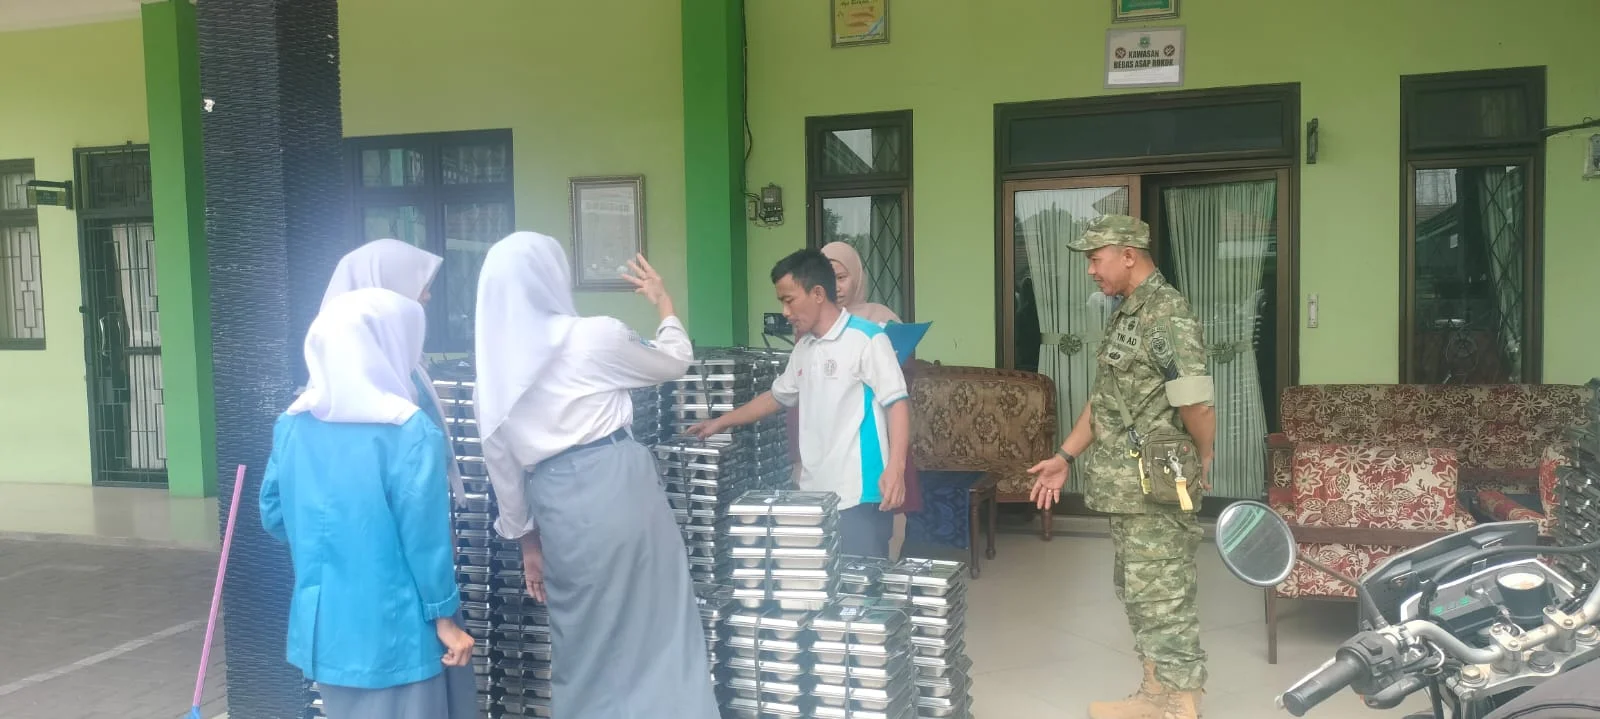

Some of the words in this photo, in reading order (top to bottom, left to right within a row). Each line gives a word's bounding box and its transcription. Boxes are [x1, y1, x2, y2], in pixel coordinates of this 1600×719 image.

[1128, 50, 1159, 58] KAWASAN
[1114, 60, 1134, 69] BEBAS
[1135, 60, 1151, 68] ASAP
[1152, 59, 1174, 67] ROKOK
[1127, 337, 1136, 345] AD
